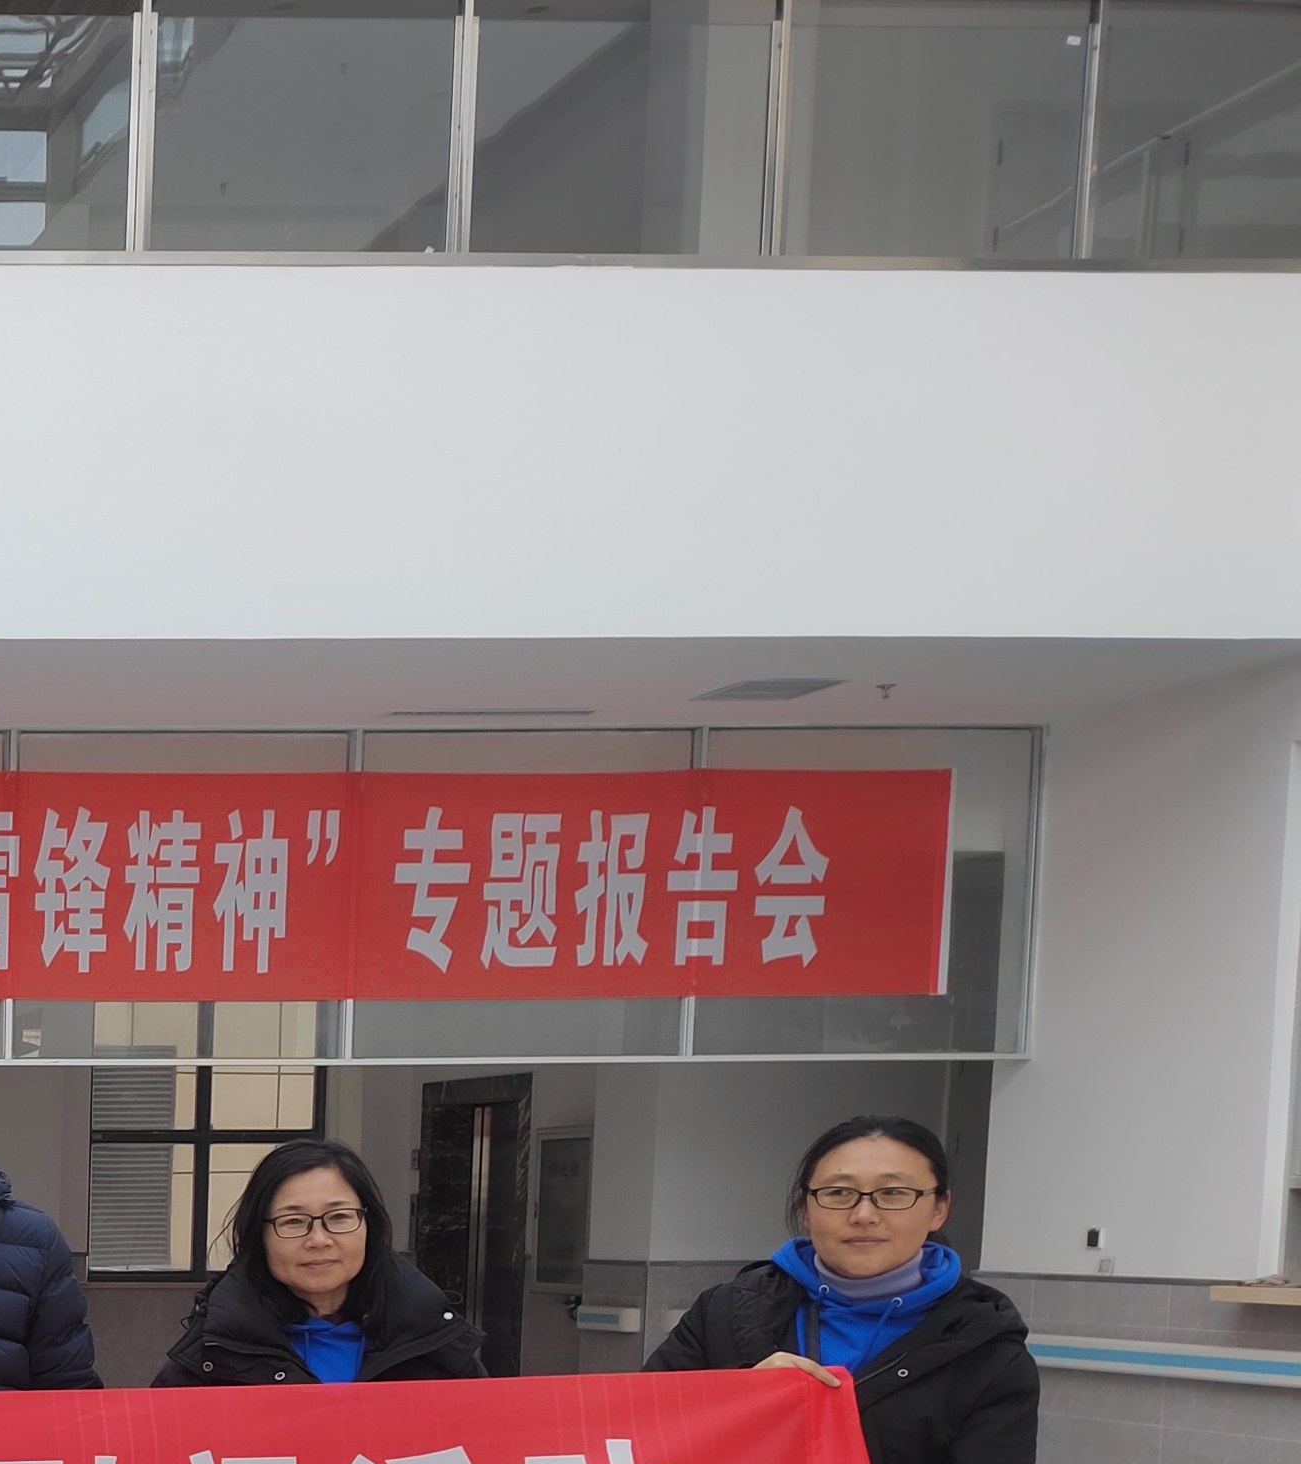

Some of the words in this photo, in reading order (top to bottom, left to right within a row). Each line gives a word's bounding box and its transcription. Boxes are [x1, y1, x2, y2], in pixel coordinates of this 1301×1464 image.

[395, 805, 829, 974] 专题报告会
